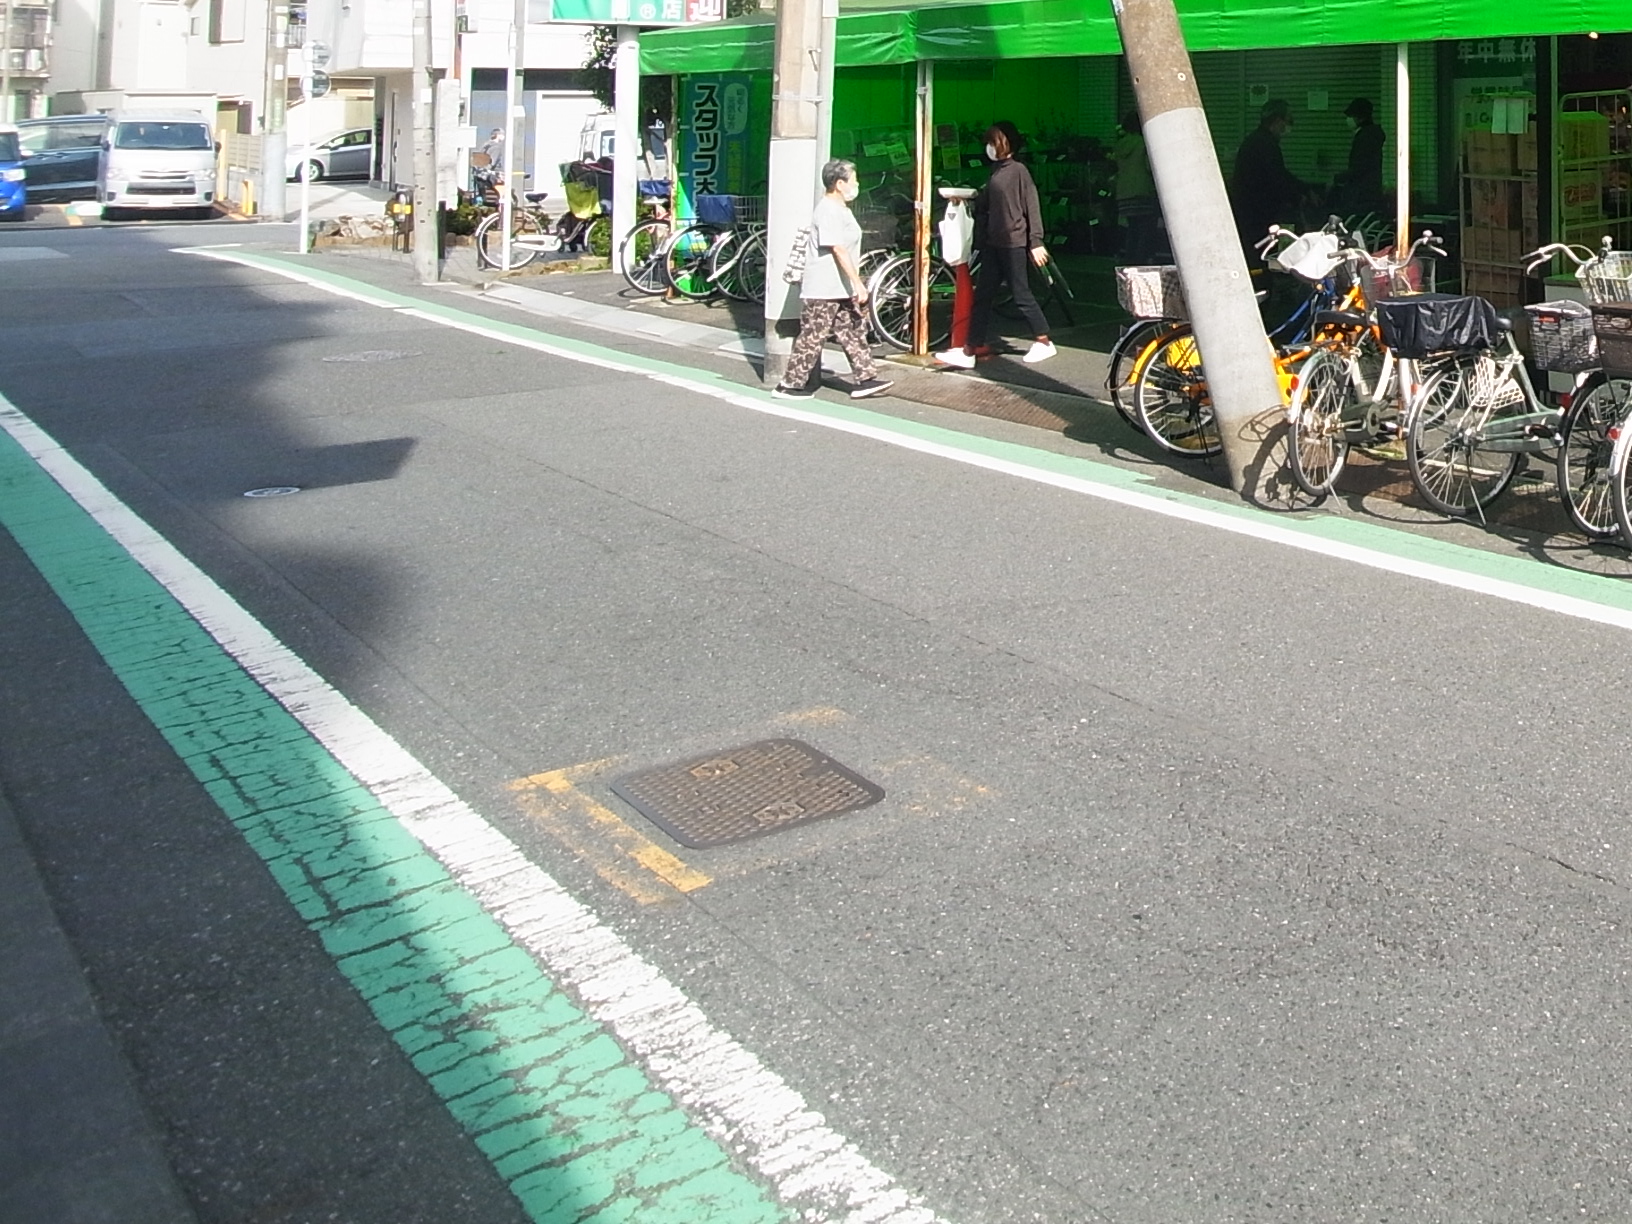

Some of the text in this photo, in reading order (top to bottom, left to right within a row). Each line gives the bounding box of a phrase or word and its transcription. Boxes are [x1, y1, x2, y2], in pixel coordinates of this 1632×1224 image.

[1457, 37, 1536, 64] 年中無休
[692, 82, 721, 195] スタッフ大
